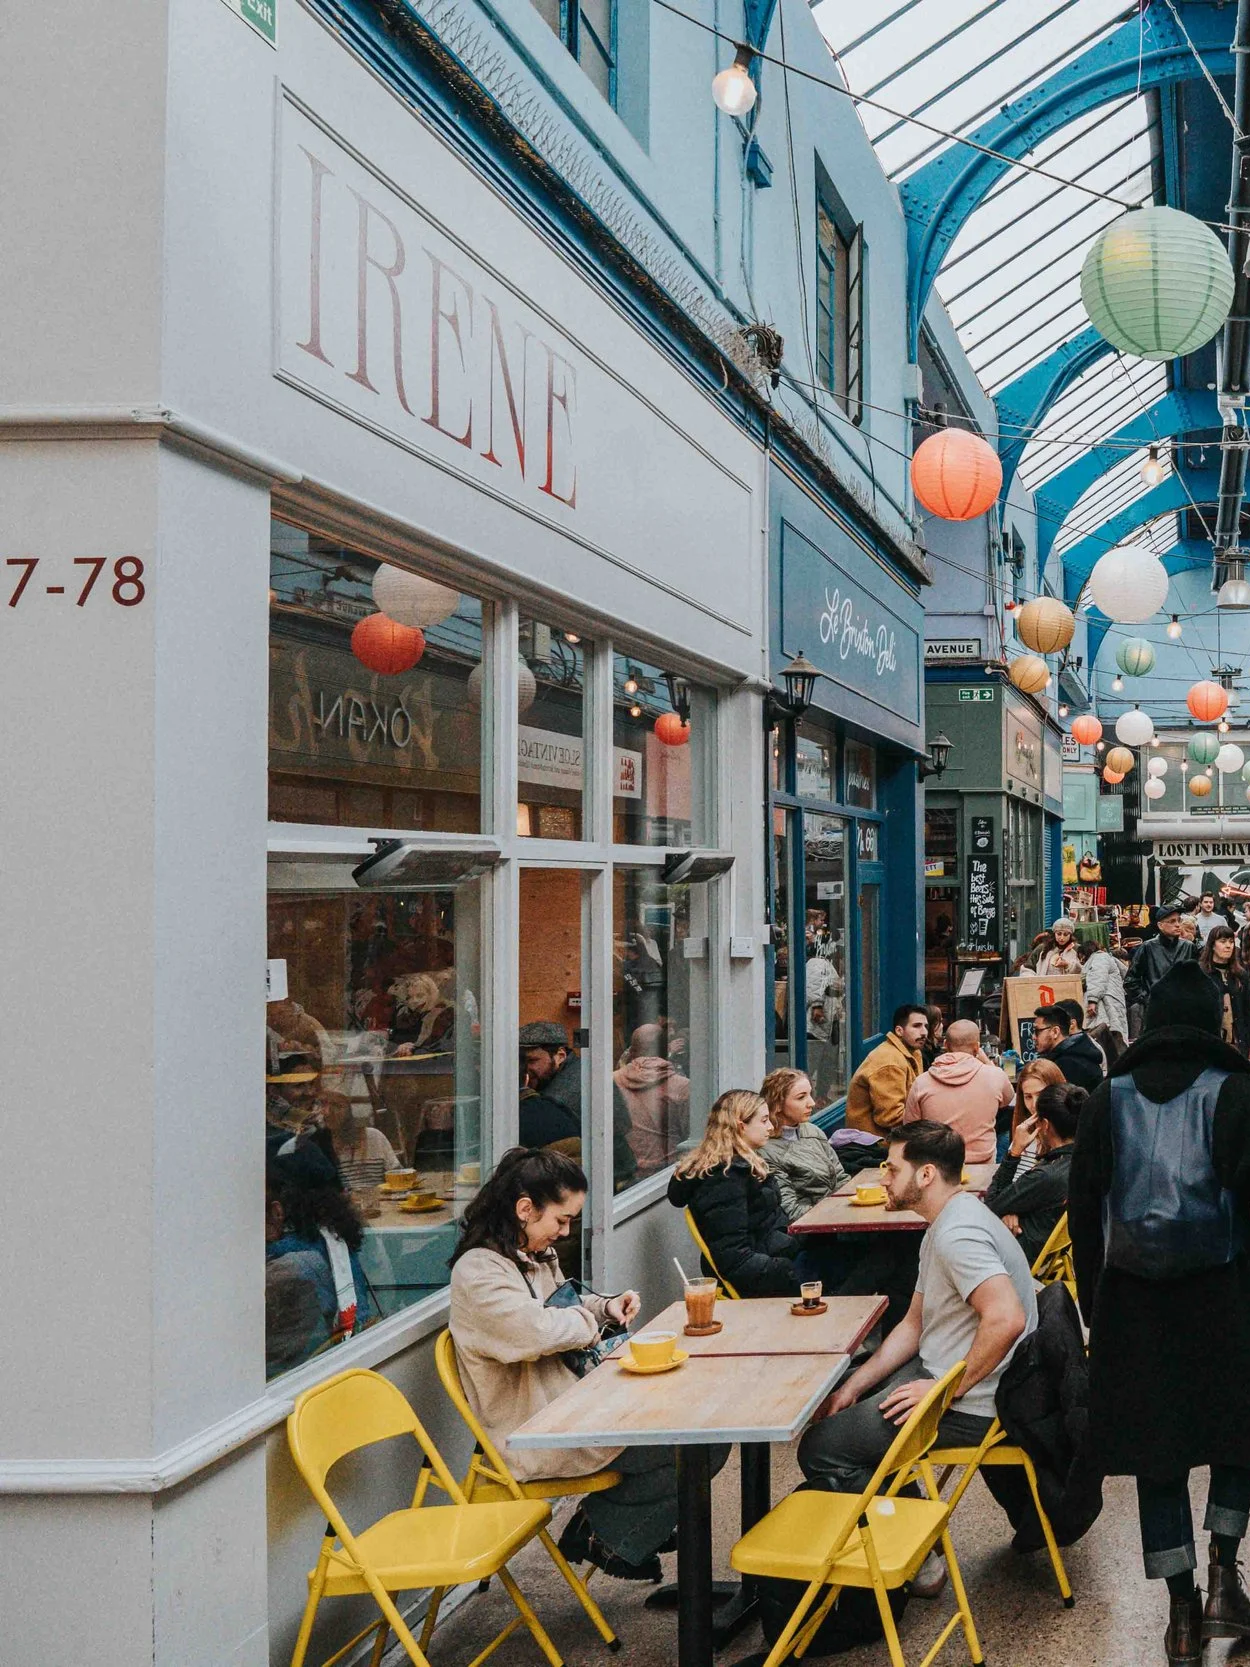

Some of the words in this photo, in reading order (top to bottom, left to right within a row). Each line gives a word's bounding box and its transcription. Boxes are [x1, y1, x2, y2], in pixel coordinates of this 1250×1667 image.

[296, 144, 577, 509] IRENE
[6, 556, 145, 607] 7-78
[820, 587, 839, 643] Le
[840, 598, 876, 660] Brixton
[876, 625, 897, 676] Deli
[926, 644, 974, 654] AVENUE
[1159, 843, 1193, 857] LOST
[1195, 843, 1209, 856] IN
[972, 860, 987, 873] The
